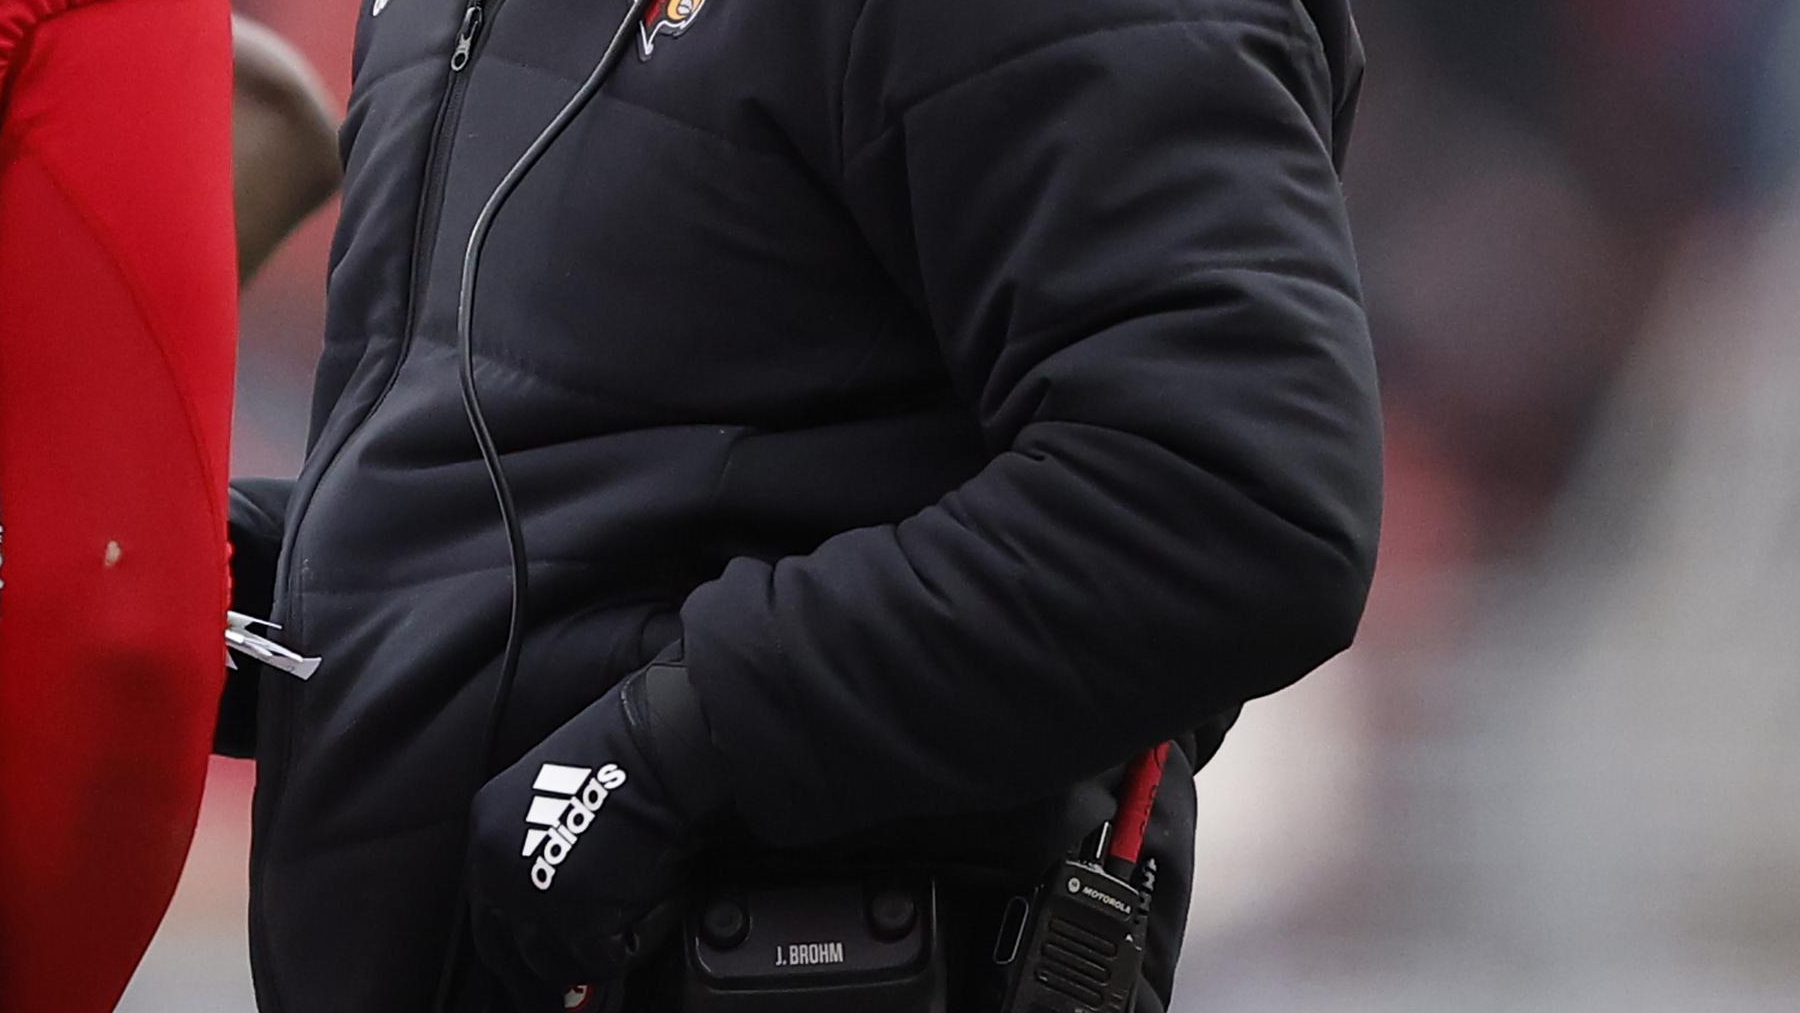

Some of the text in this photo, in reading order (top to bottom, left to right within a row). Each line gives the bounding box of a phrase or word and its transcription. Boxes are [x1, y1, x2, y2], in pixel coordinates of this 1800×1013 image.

[531, 763, 627, 890] adidas
[1082, 886, 1131, 914] MOTOROLA
[776, 942, 844, 966] J. BROHM
